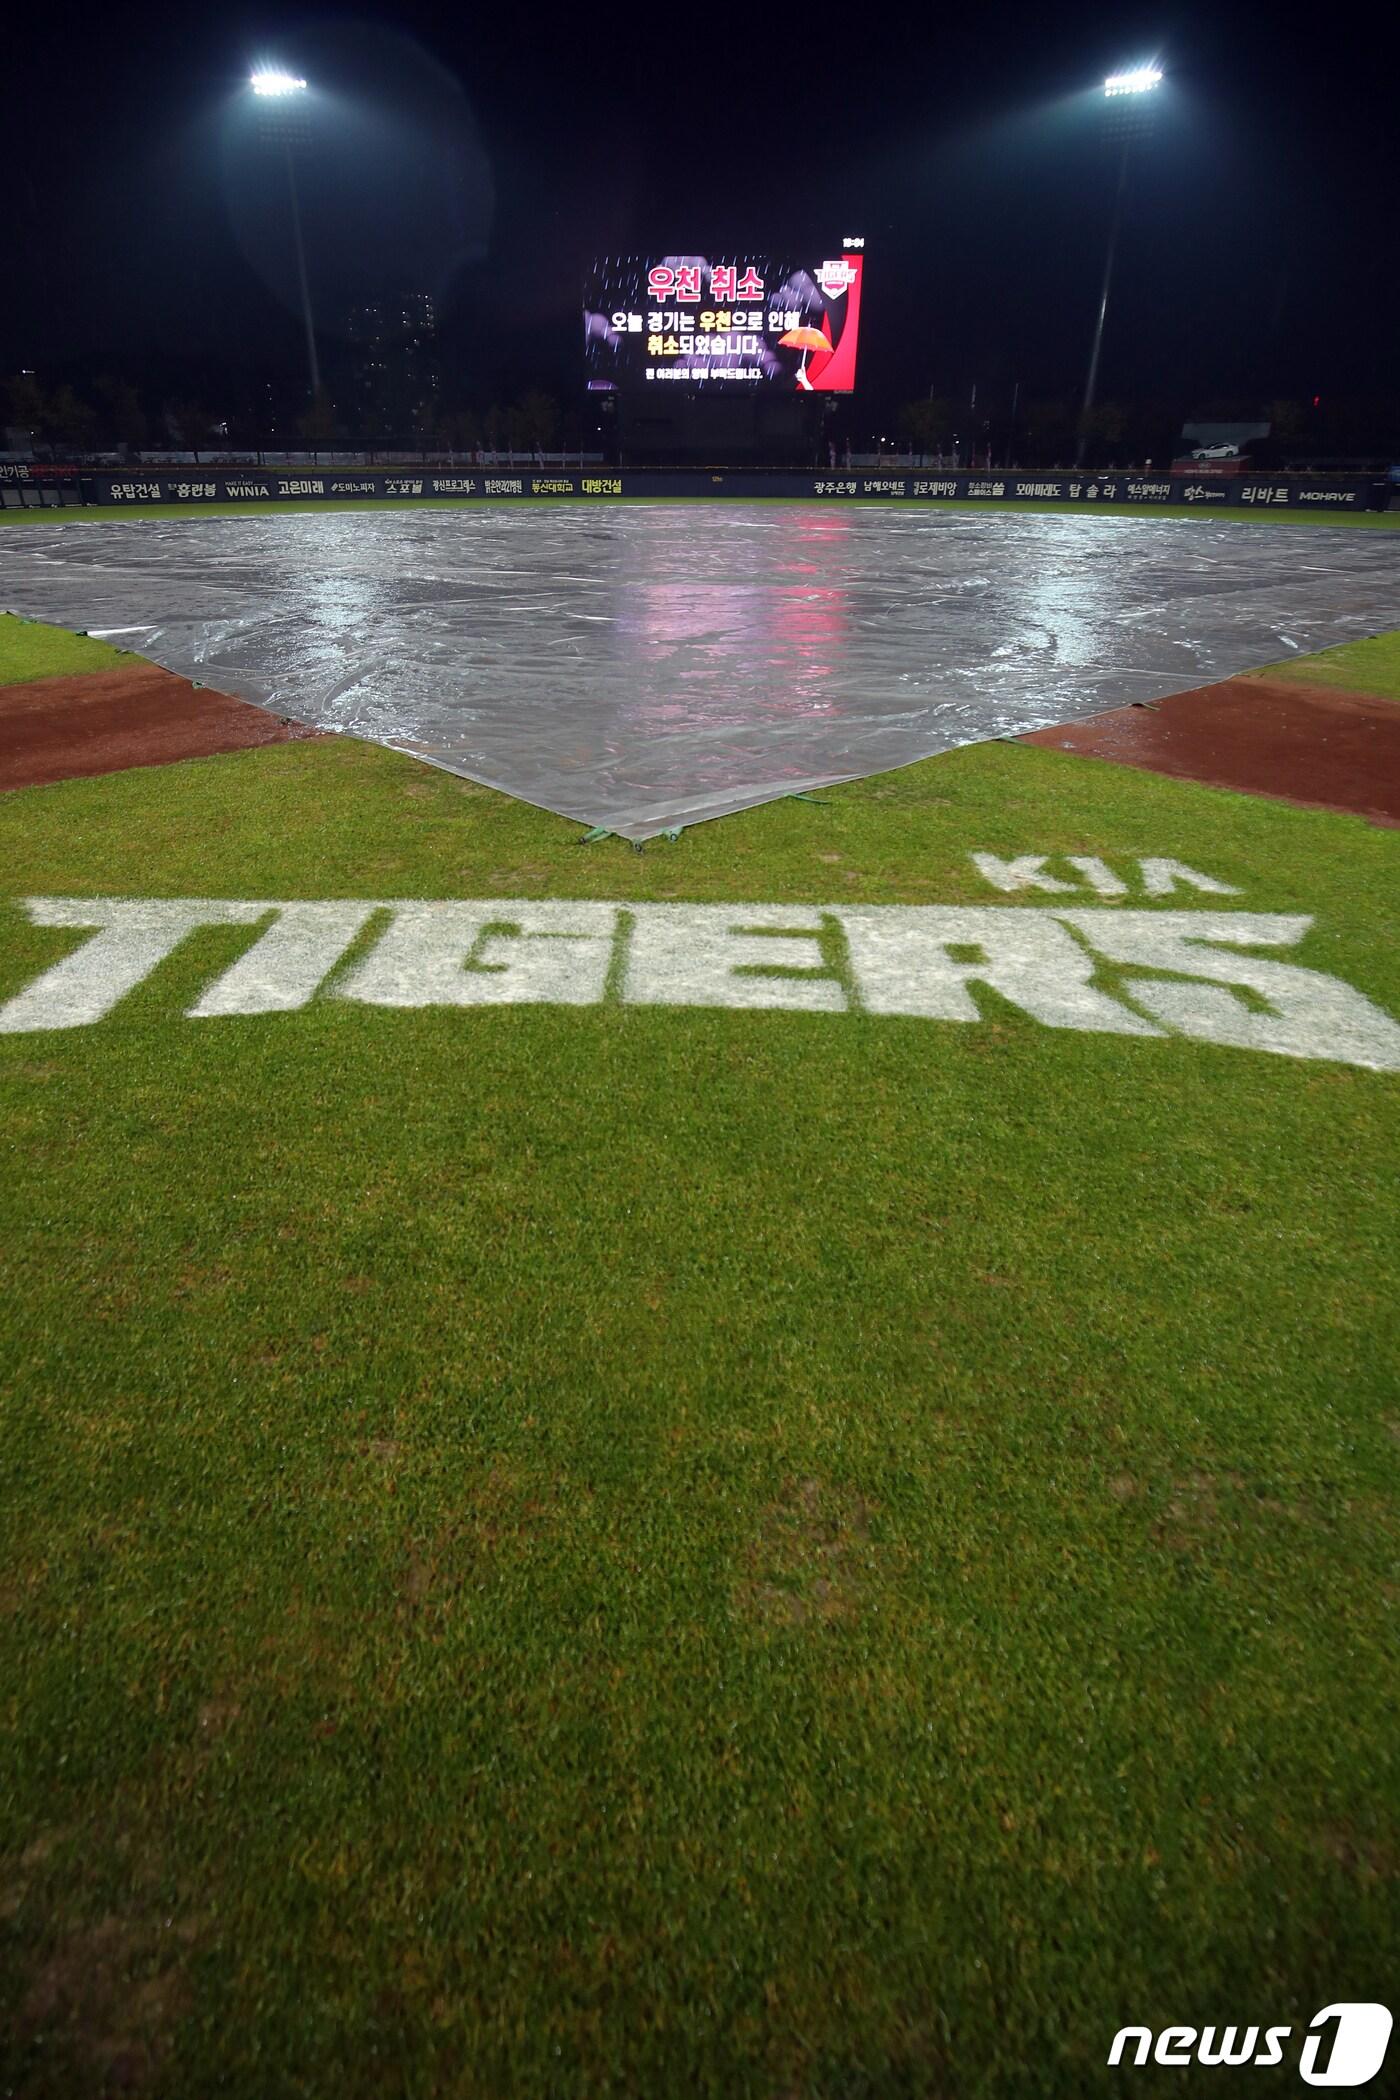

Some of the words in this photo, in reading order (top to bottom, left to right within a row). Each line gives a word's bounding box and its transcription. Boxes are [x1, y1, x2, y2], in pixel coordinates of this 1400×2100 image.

[647, 266, 702, 303] 우천
[710, 266, 764, 303] 취소
[611, 312, 643, 332] 오늘
[647, 312, 695, 332] 경기는
[698, 311, 763, 332] 우천으로
[768, 311, 800, 332] 인해
[647, 335, 763, 356] 취소되었습니다.
[111, 483, 162, 499] 유탑건설
[226, 486, 270, 497] WINIA
[338, 482, 375, 493] 도미노피자
[432, 479, 476, 494] 광신프로그레스
[581, 479, 622, 494] 대방건설
[814, 481, 857, 495] 광주은행
[1016, 483, 1062, 497] 모아미래도
[1241, 486, 1289, 504] 리바트
[1299, 491, 1356, 502] MOHAVE
[968, 852, 1246, 896] KIA
[0, 895, 1400, 1072] TIGERS
